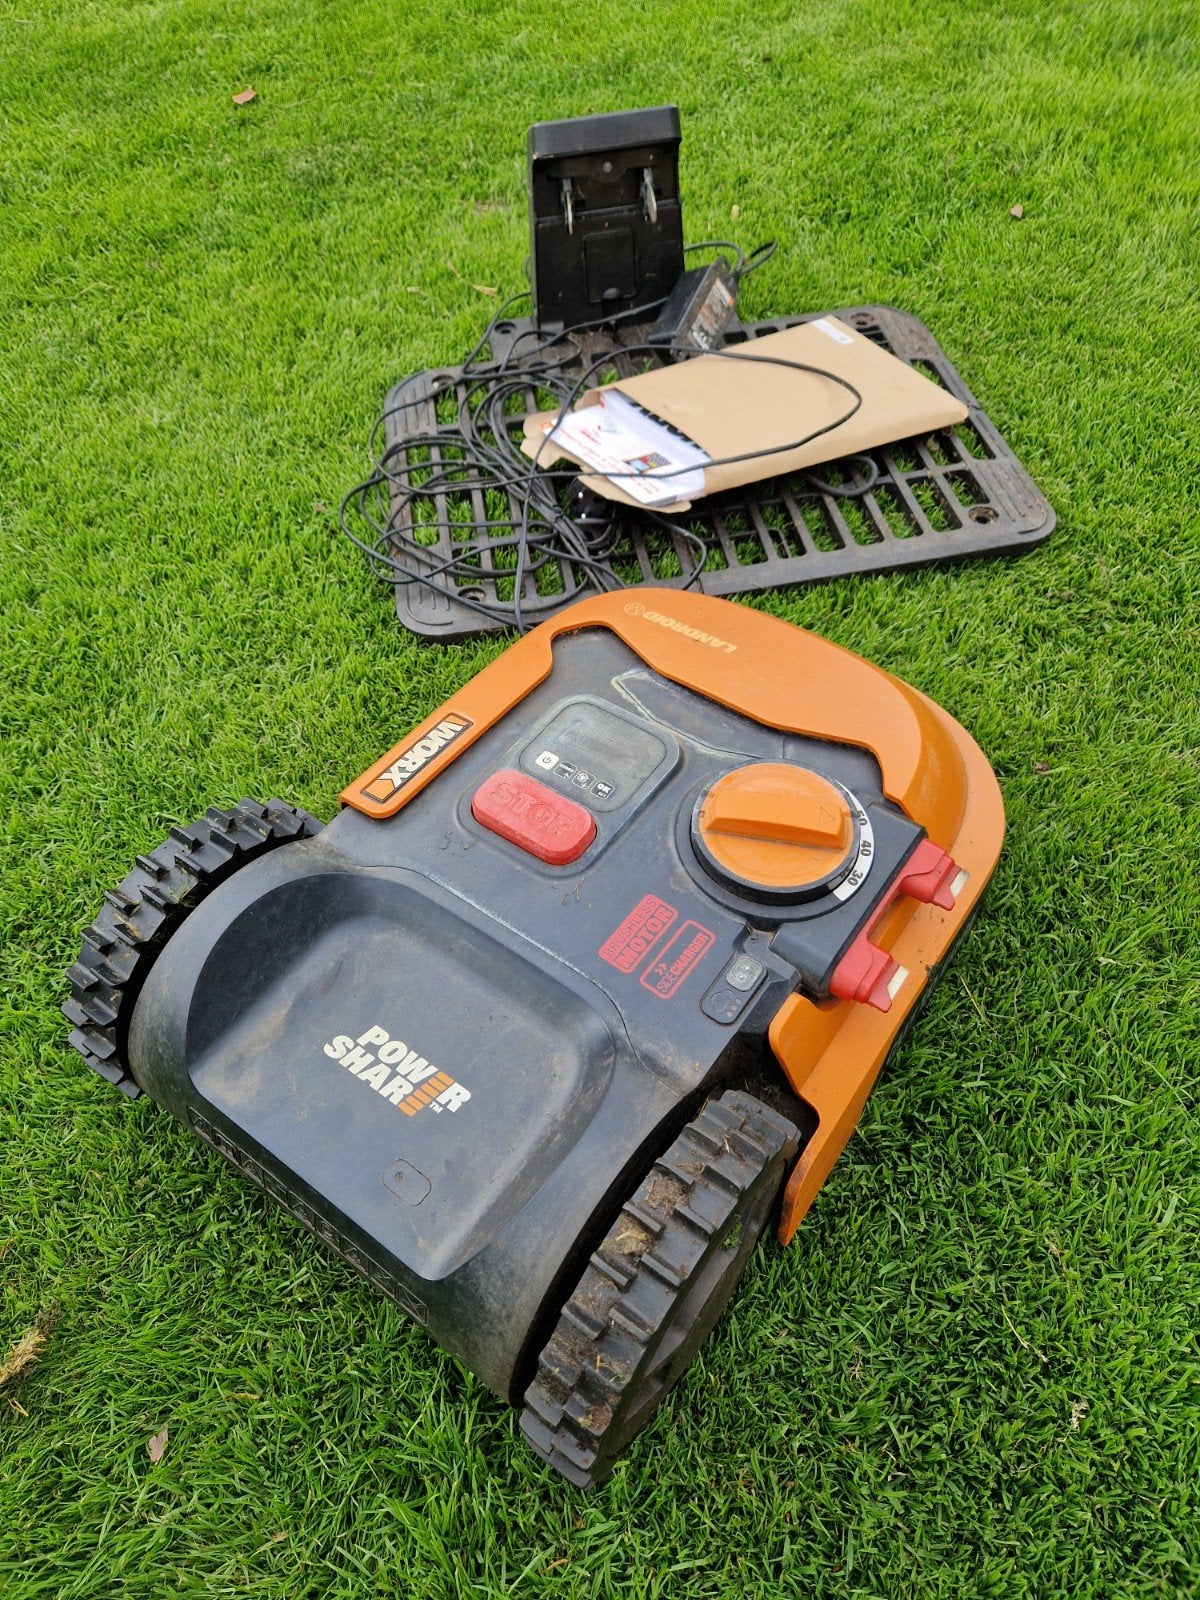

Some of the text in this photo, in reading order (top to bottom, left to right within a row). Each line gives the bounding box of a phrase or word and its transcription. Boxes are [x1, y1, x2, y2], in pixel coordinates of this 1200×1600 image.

[643, 611, 738, 654] LANDROID
[377, 720, 464, 789] WORX
[489, 782, 575, 835] STOP
[597, 783, 611, 794] OK
[860, 840, 872, 857] 40
[847, 869, 864, 886] 30
[604, 898, 657, 959] BRUSHLESS
[617, 905, 673, 968] MOTOR
